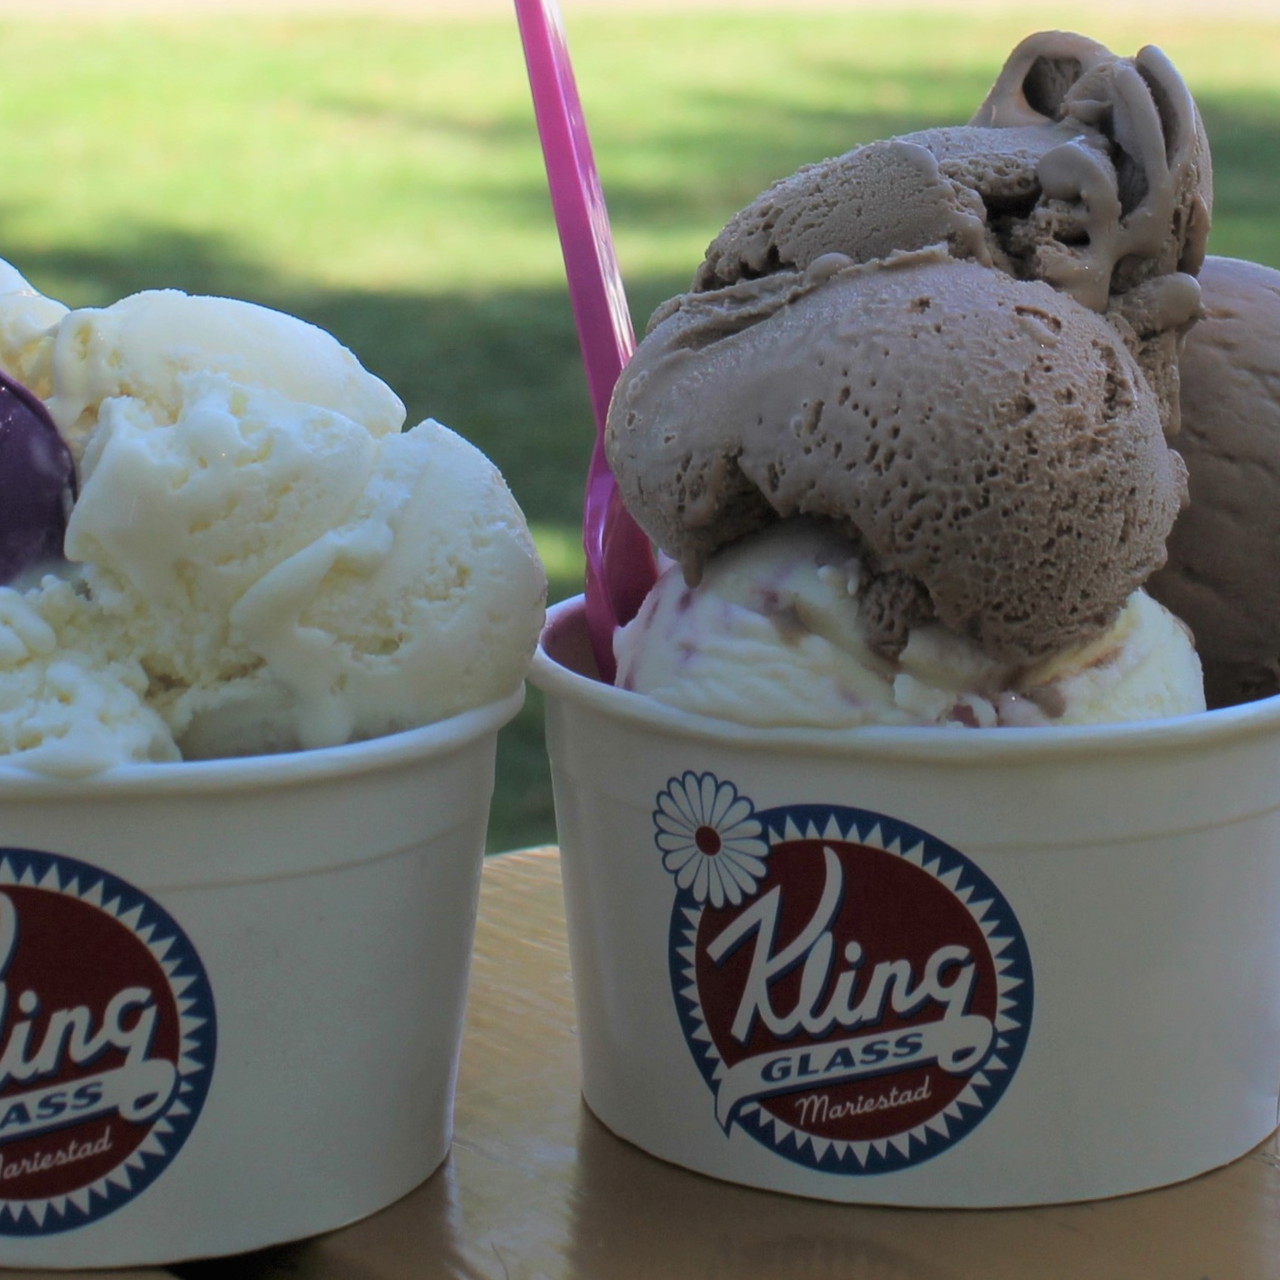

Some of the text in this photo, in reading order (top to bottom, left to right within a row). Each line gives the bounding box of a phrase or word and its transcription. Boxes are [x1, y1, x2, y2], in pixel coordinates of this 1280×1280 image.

[706, 846, 993, 1072] Kling
[761, 1033, 922, 1082] GLASS
[795, 1075, 932, 1125] Mariestad
